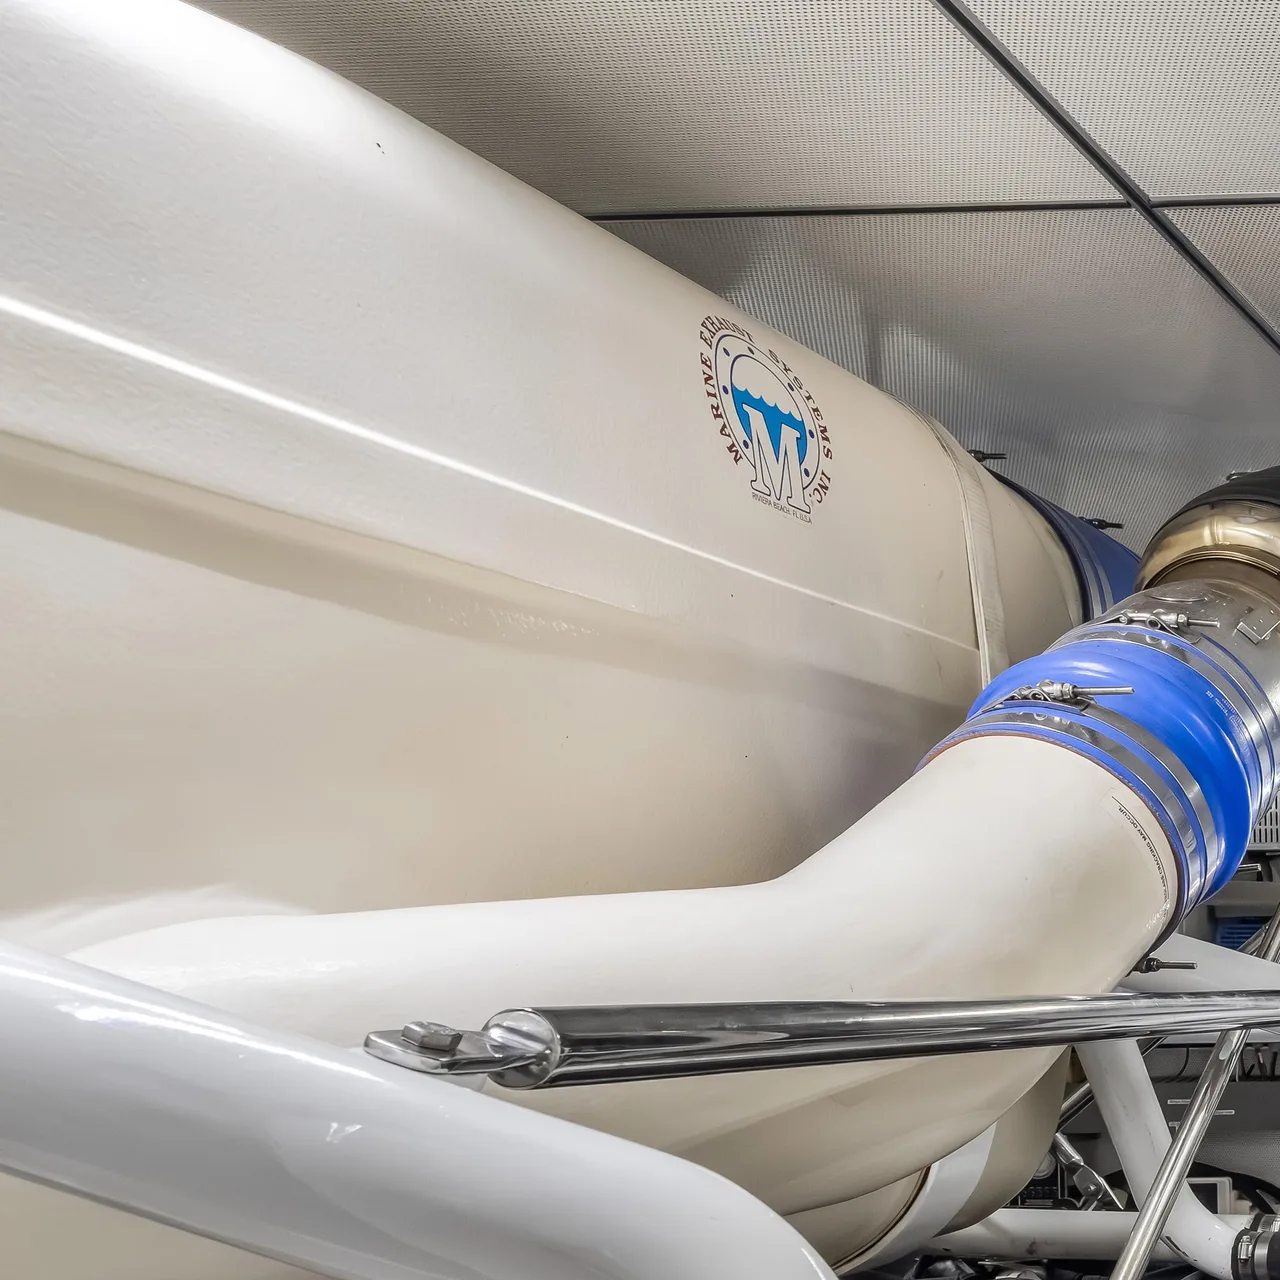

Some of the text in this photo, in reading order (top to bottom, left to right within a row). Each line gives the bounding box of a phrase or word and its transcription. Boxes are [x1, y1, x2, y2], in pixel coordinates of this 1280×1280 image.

[700, 315, 755, 350] EXHAUST
[700, 352, 743, 465] MARINE
[768, 348, 832, 460] SYSTEMS
[1136, 827, 1148, 842] MAY
